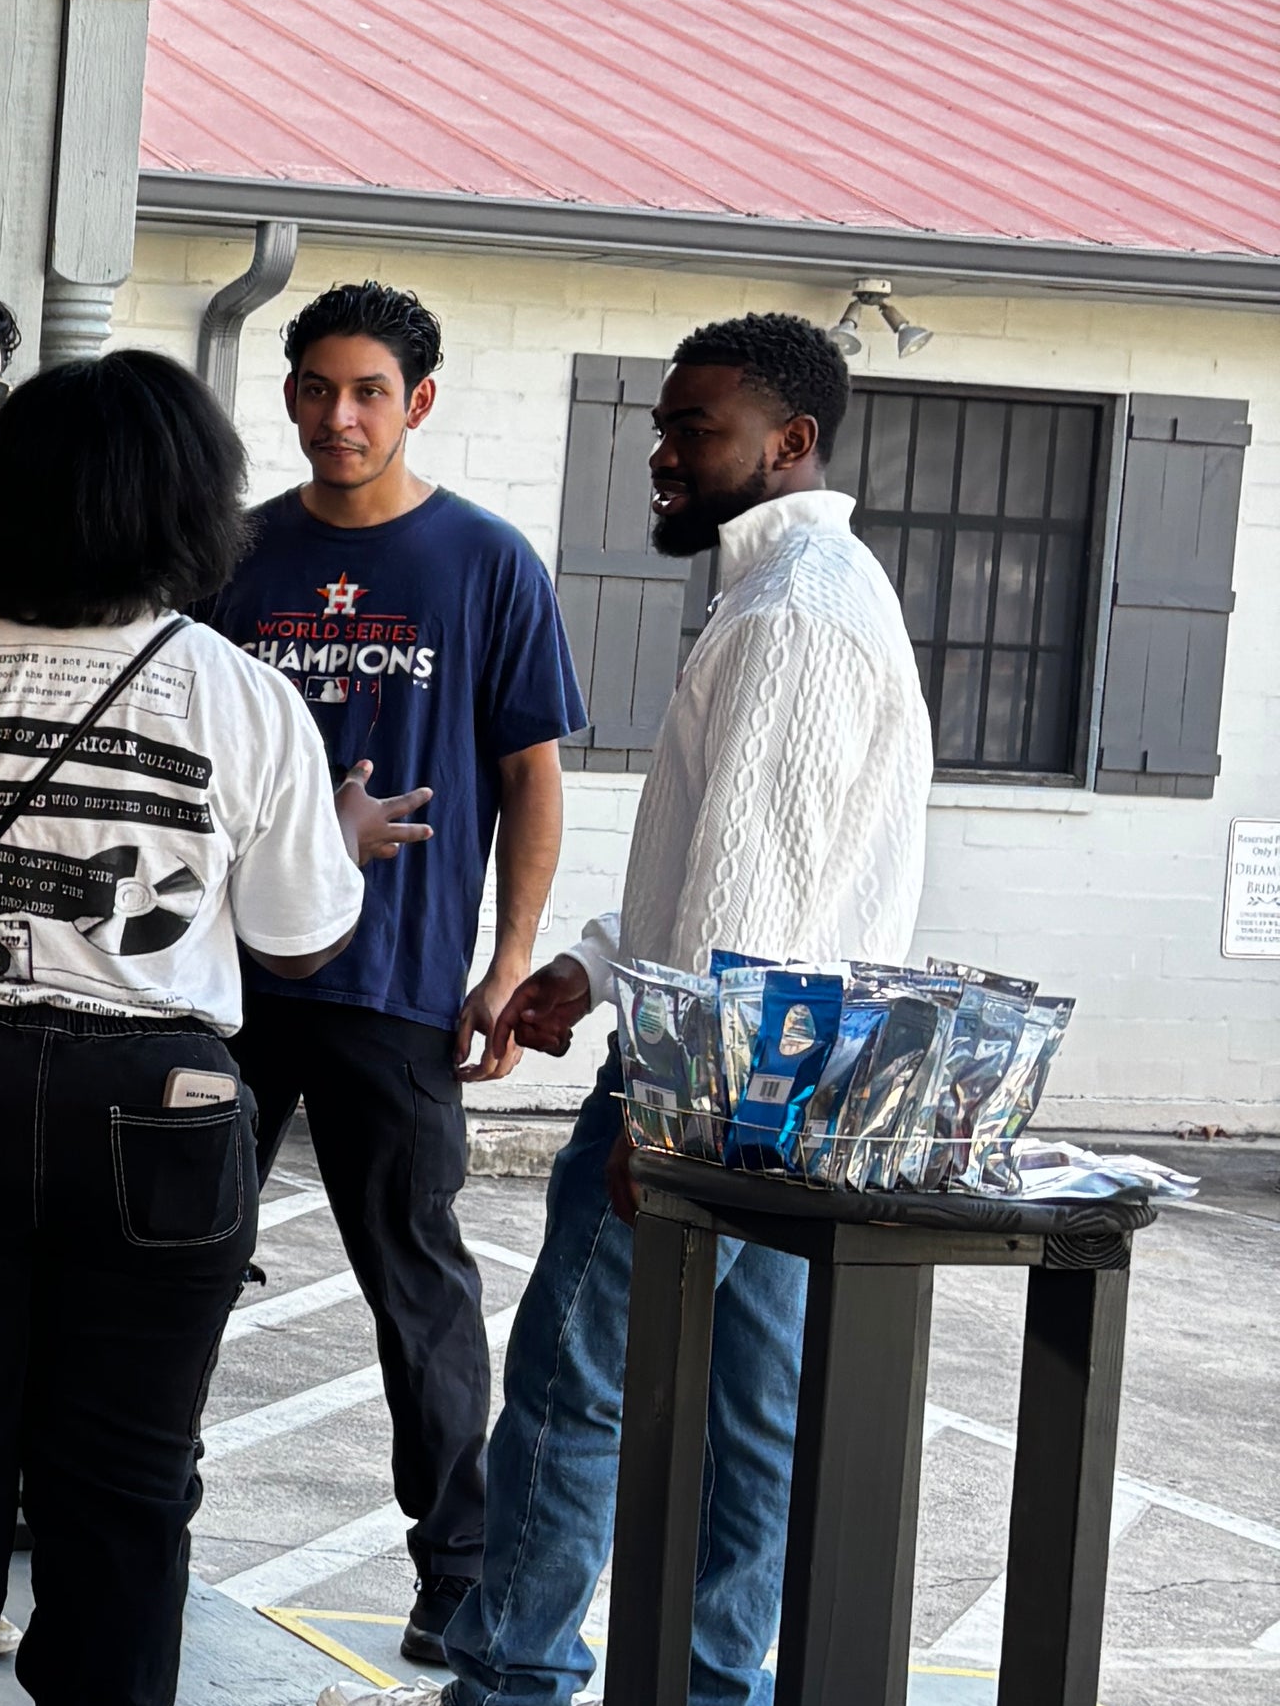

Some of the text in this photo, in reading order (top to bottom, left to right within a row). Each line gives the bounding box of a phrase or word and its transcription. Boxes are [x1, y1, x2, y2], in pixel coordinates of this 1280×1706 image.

[323, 583, 359, 615] H
[257, 620, 417, 641] WORLD SERIES
[62, 657, 81, 666] not
[85, 657, 111, 669] just
[25, 670, 43, 679] the
[48, 672, 87, 684] things
[15, 729, 35, 743] OF
[35, 733, 137, 756] AMRICAN
[138, 752, 207, 780] CULTURE
[51, 794, 79, 807] WHO
[84, 796, 141, 813] DEFINED
[145, 803, 172, 818] OUR
[1238, 834, 1274, 844] Reserved
[1252, 847, 1272, 858] Only
[19, 855, 83, 877] CAPTURED
[88, 869, 114, 884] THE
[8, 875, 34, 889] JOY
[40, 880, 57, 893] OF
[61, 883, 84, 900] THE
[0, 895, 56, 915] DECADES
